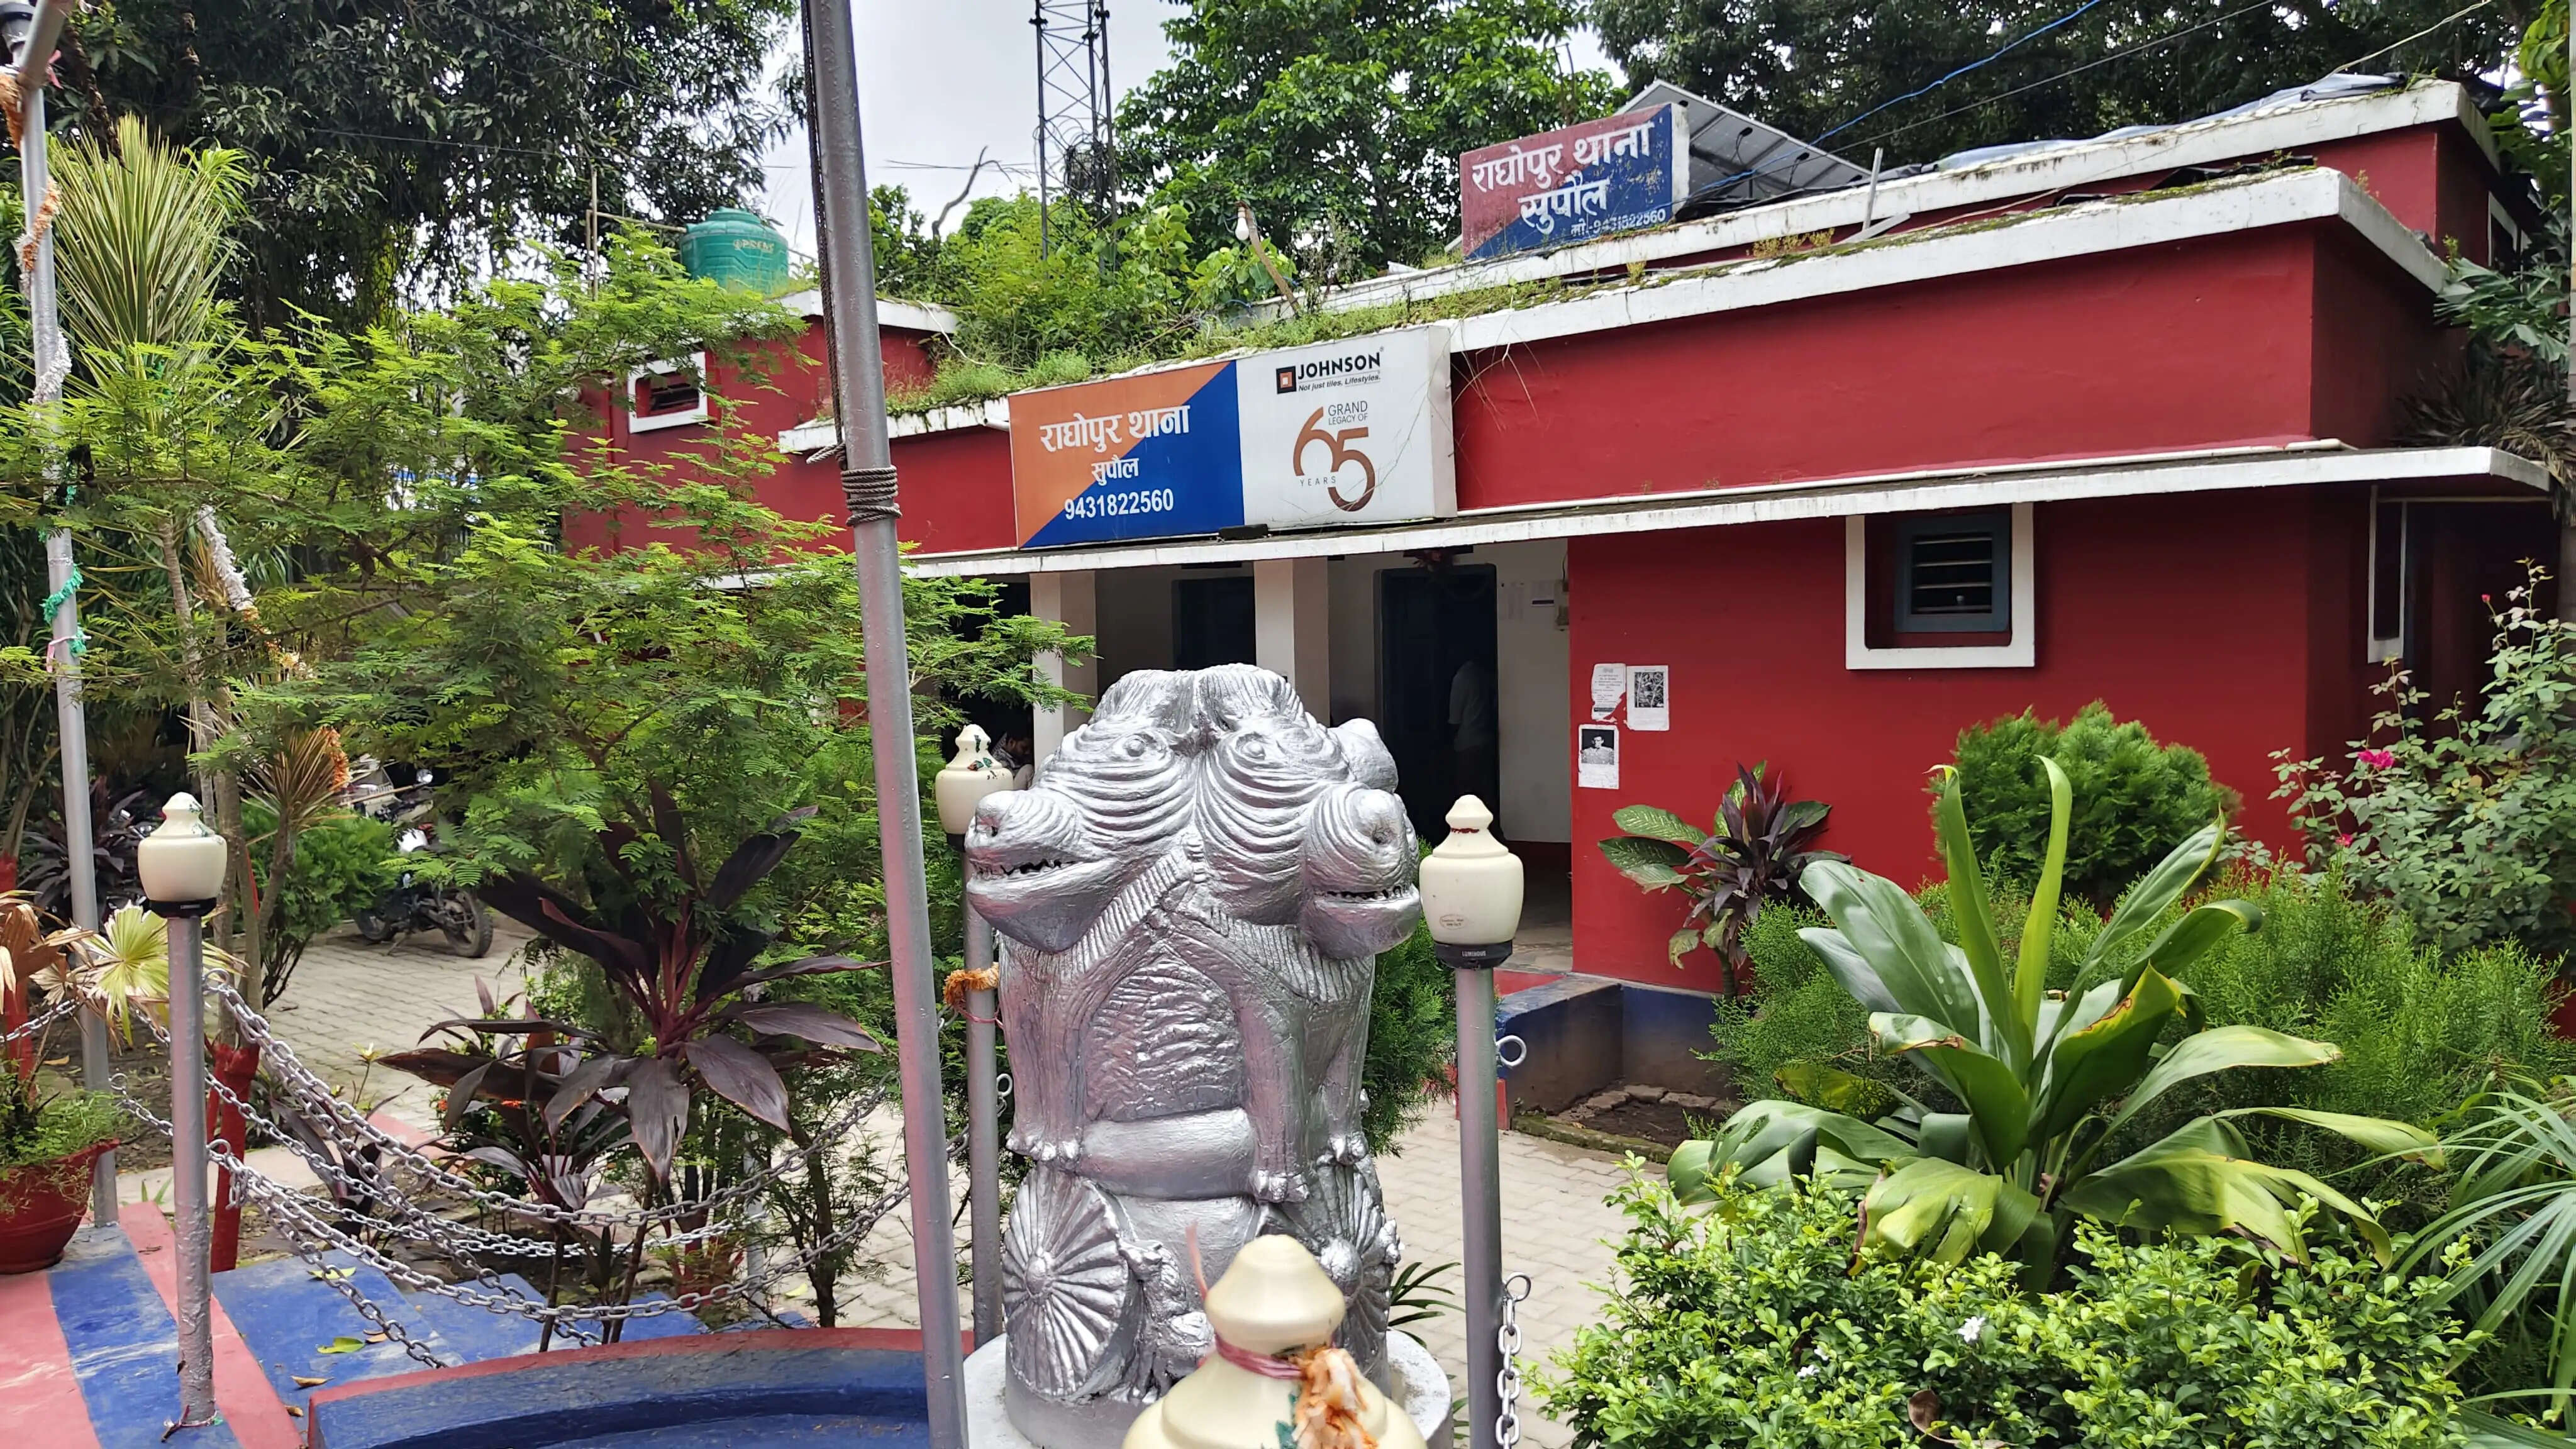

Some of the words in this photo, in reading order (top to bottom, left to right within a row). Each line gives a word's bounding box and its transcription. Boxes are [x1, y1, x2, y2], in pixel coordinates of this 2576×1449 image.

[1472, 145, 1564, 192] राघोपुर
[1572, 121, 1655, 166] थाना
[1518, 170, 1611, 234] सुपौल
[1297, 352, 1380, 380] JOHNSON
[1311, 382, 1325, 391] just
[1328, 400, 1368, 416] GRAND
[1328, 414, 1356, 425] LEGACY
[1357, 413, 1368, 422] OF
[1040, 413, 1123, 453] राघोपुर
[1127, 404, 1191, 439] थाना
[1091, 454, 1140, 486] सुपौल
[1292, 406, 1375, 512] 65
[1300, 476, 1336, 487] YEARS
[1063, 488, 1174, 520] 9431822560
